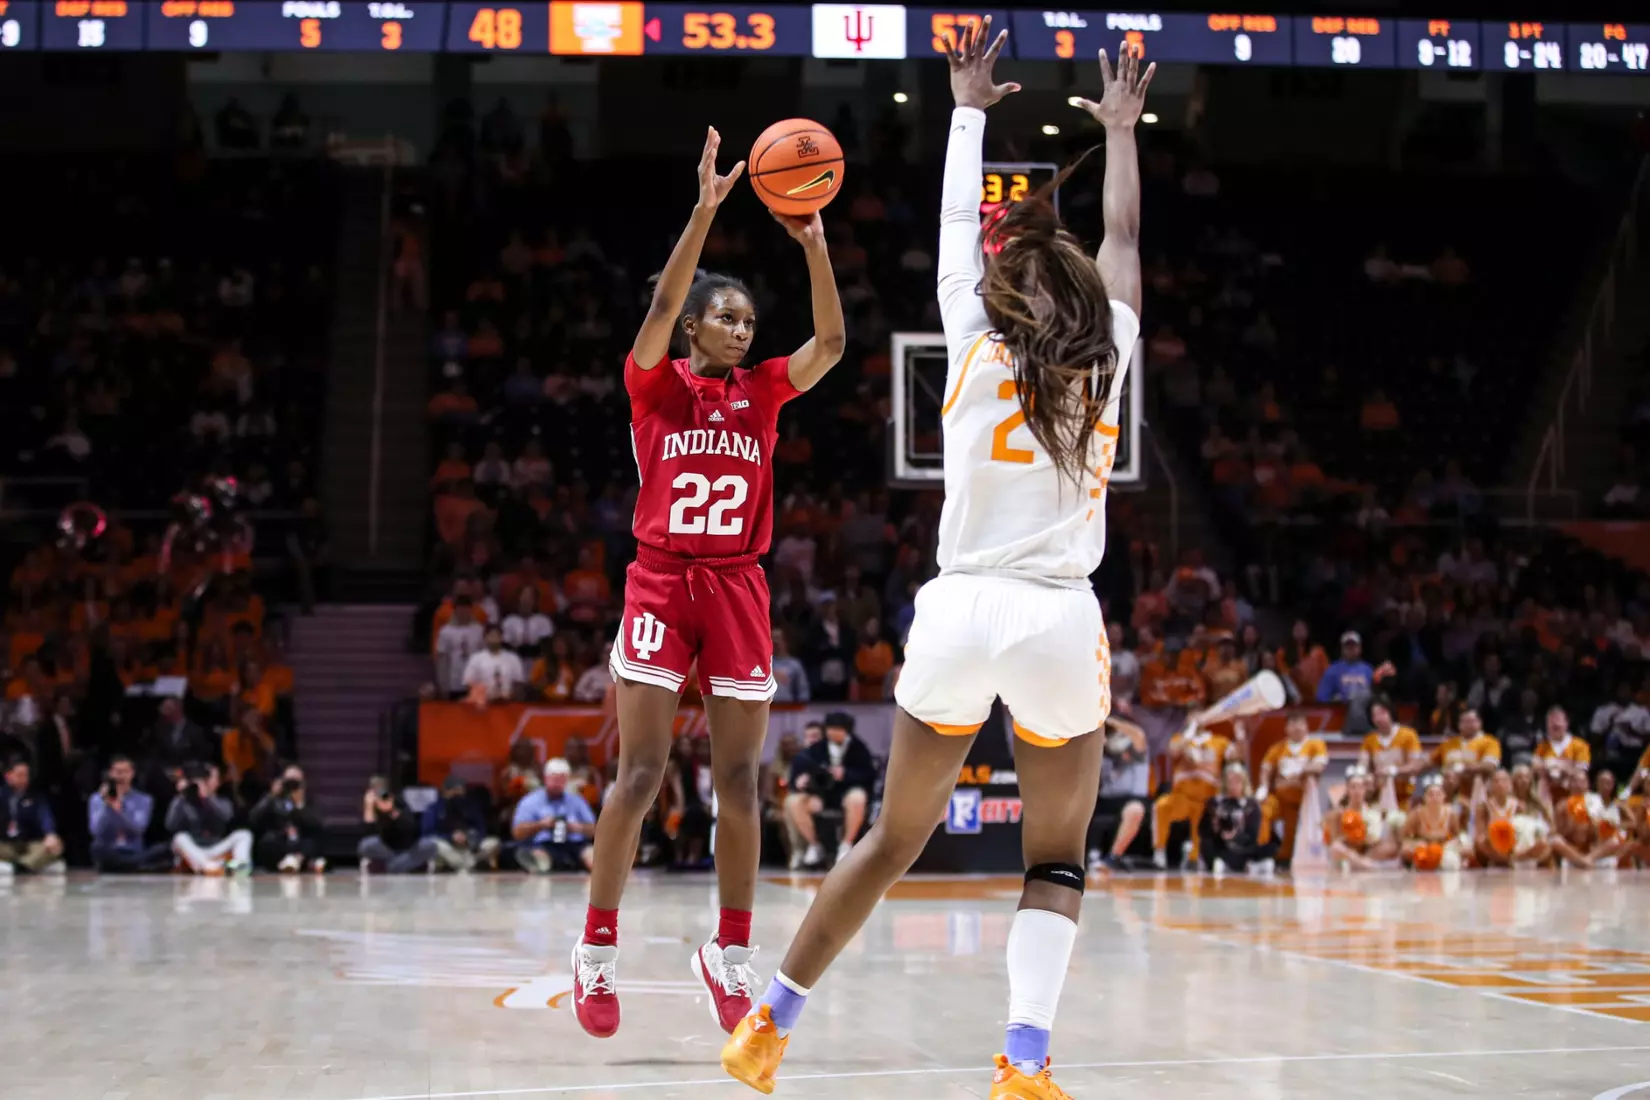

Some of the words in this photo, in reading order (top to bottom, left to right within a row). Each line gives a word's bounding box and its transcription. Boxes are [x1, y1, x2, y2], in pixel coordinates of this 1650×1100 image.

[300, 18, 321, 48] 5
[381, 21, 402, 50] 3
[468, 8, 523, 49] 48
[683, 13, 775, 50] 53.3
[1055, 29, 1075, 58] 3
[662, 429, 761, 466] INDIANA
[668, 472, 749, 536] 22
